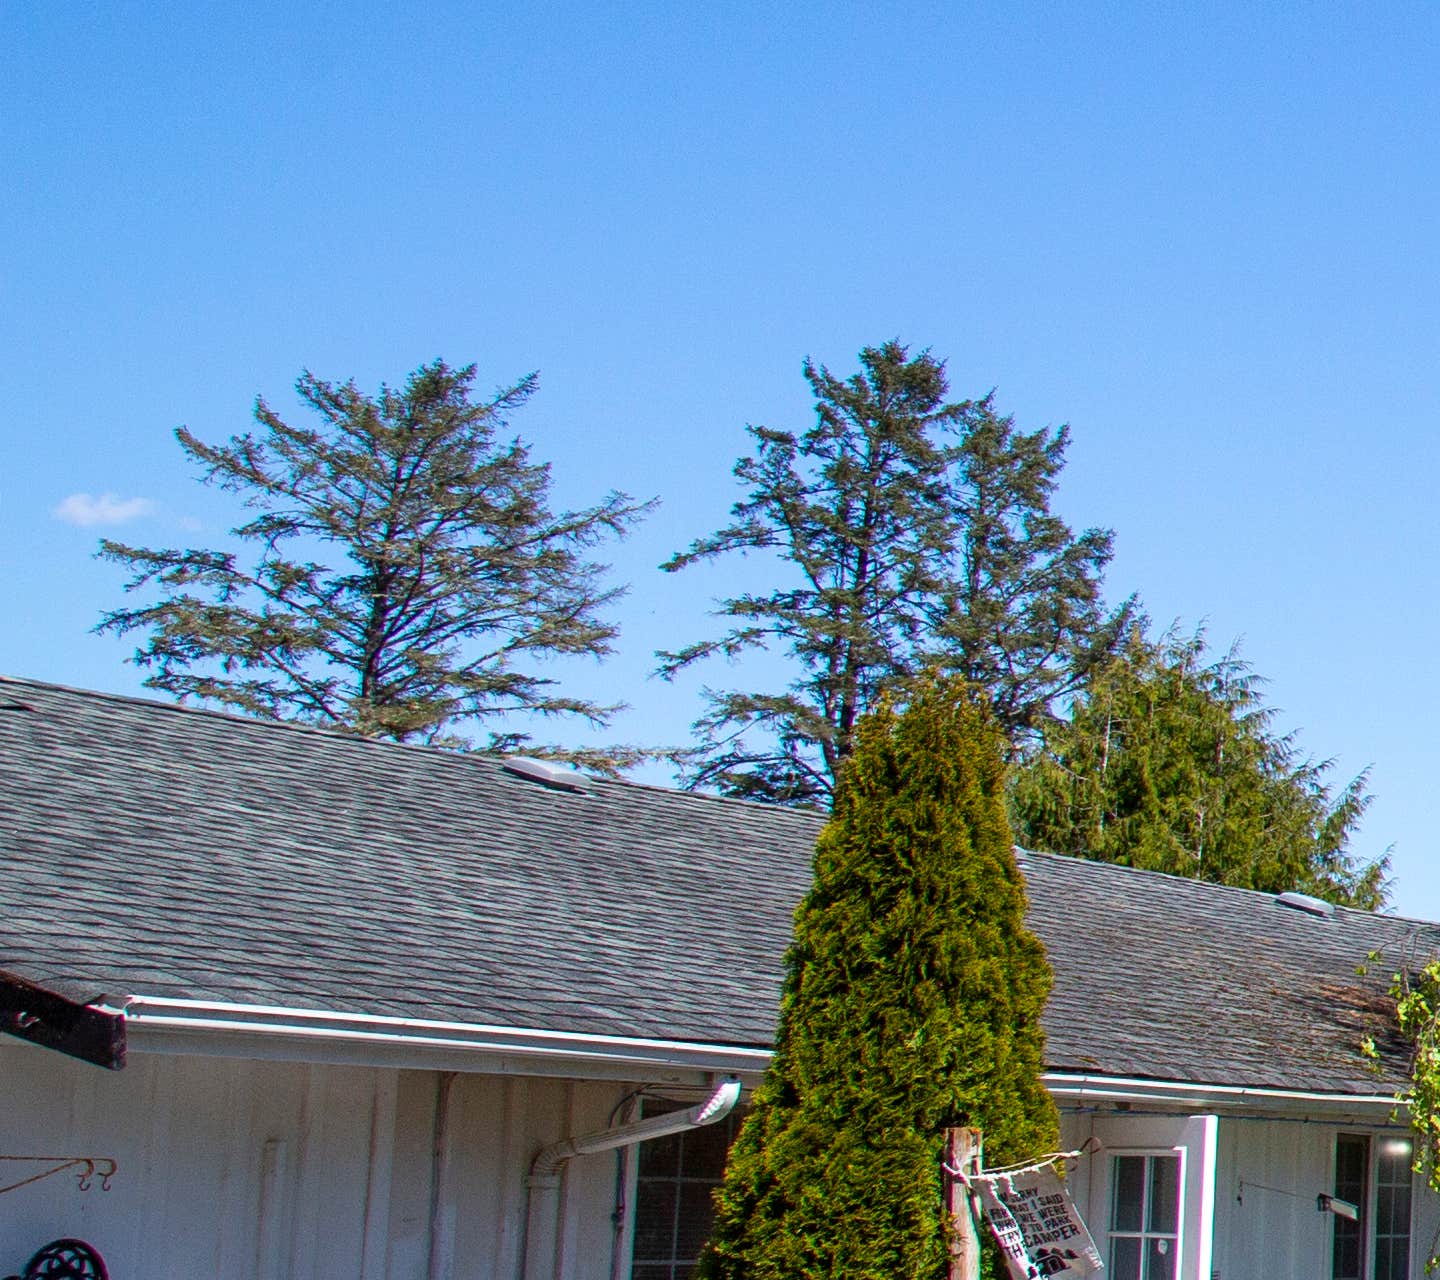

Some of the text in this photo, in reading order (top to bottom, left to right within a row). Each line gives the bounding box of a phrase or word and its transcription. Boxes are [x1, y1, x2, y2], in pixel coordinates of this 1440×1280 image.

[1038, 1193, 1064, 1206] SAID
[1037, 1204, 1067, 1220] WERE
[1031, 1223, 1044, 1233] TO
[1046, 1214, 1073, 1231] PARK
[1025, 1223, 1081, 1247] CAMPER
